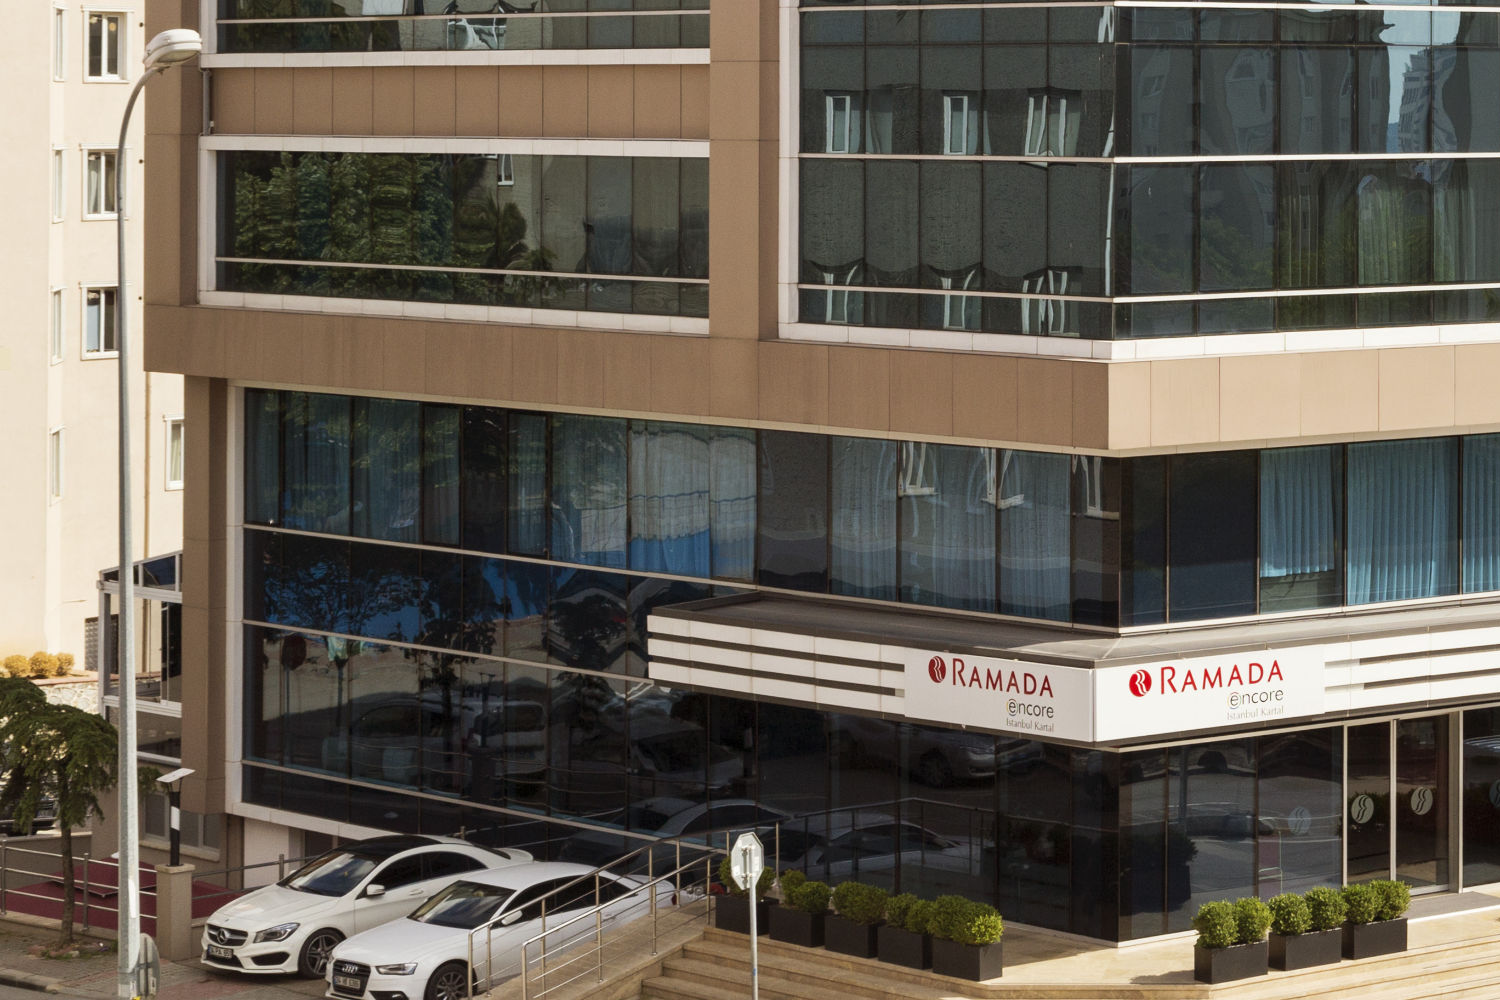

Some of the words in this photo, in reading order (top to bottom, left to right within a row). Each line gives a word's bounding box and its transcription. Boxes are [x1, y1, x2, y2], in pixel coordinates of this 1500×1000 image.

[952, 658, 1054, 698] RAMADA
[1160, 659, 1284, 695] RAMADA
[1007, 699, 1054, 718] encore
[1227, 690, 1284, 710] encore
[1227, 708, 1258, 720] Istanbul
[1261, 705, 1284, 716] Kartal
[1006, 717, 1033, 729] Istanbul
[1034, 721, 1054, 732] Kartal
